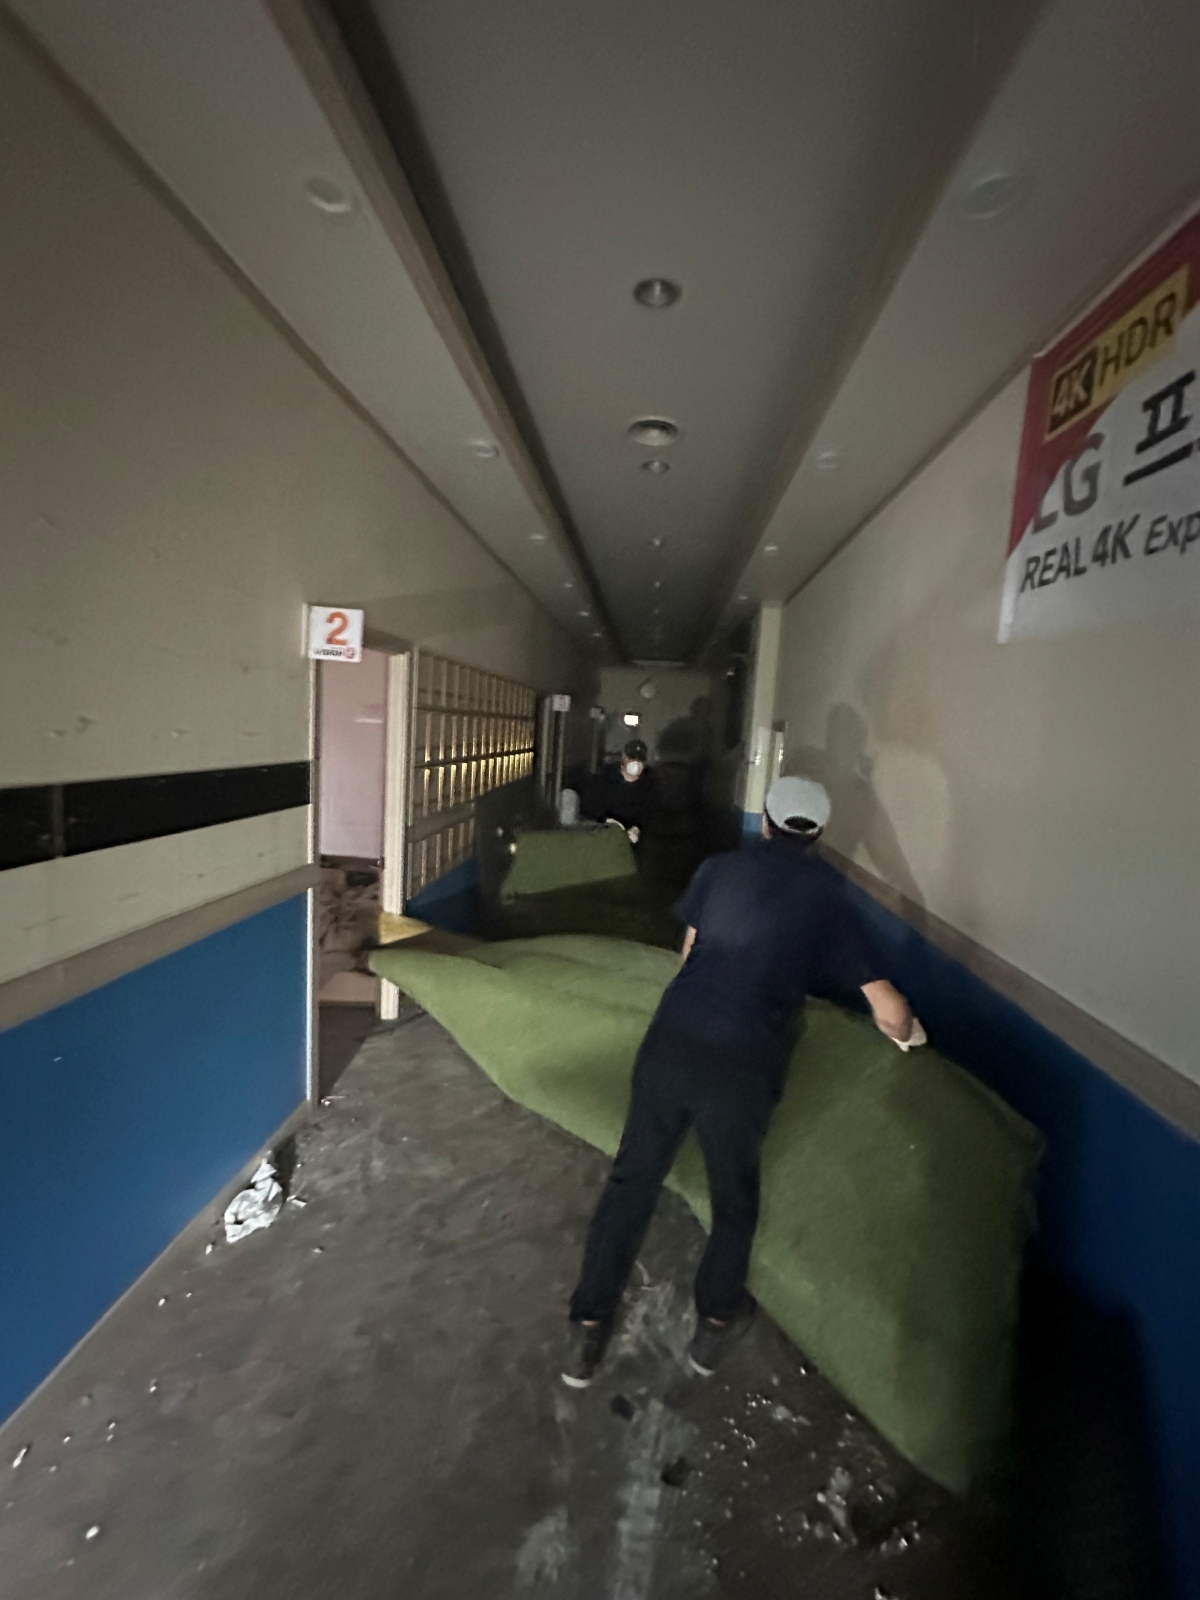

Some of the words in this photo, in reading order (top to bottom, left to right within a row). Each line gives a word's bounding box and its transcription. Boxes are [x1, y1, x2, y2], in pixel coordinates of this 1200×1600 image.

[1053, 358, 1092, 417] 4K
[1099, 292, 1176, 387] HDR
[1031, 432, 1103, 534] LG
[1123, 369, 1200, 486] 프
[1021, 537, 1087, 593] REAL
[1091, 514, 1140, 567] 4K
[326, 611, 348, 645] 2
